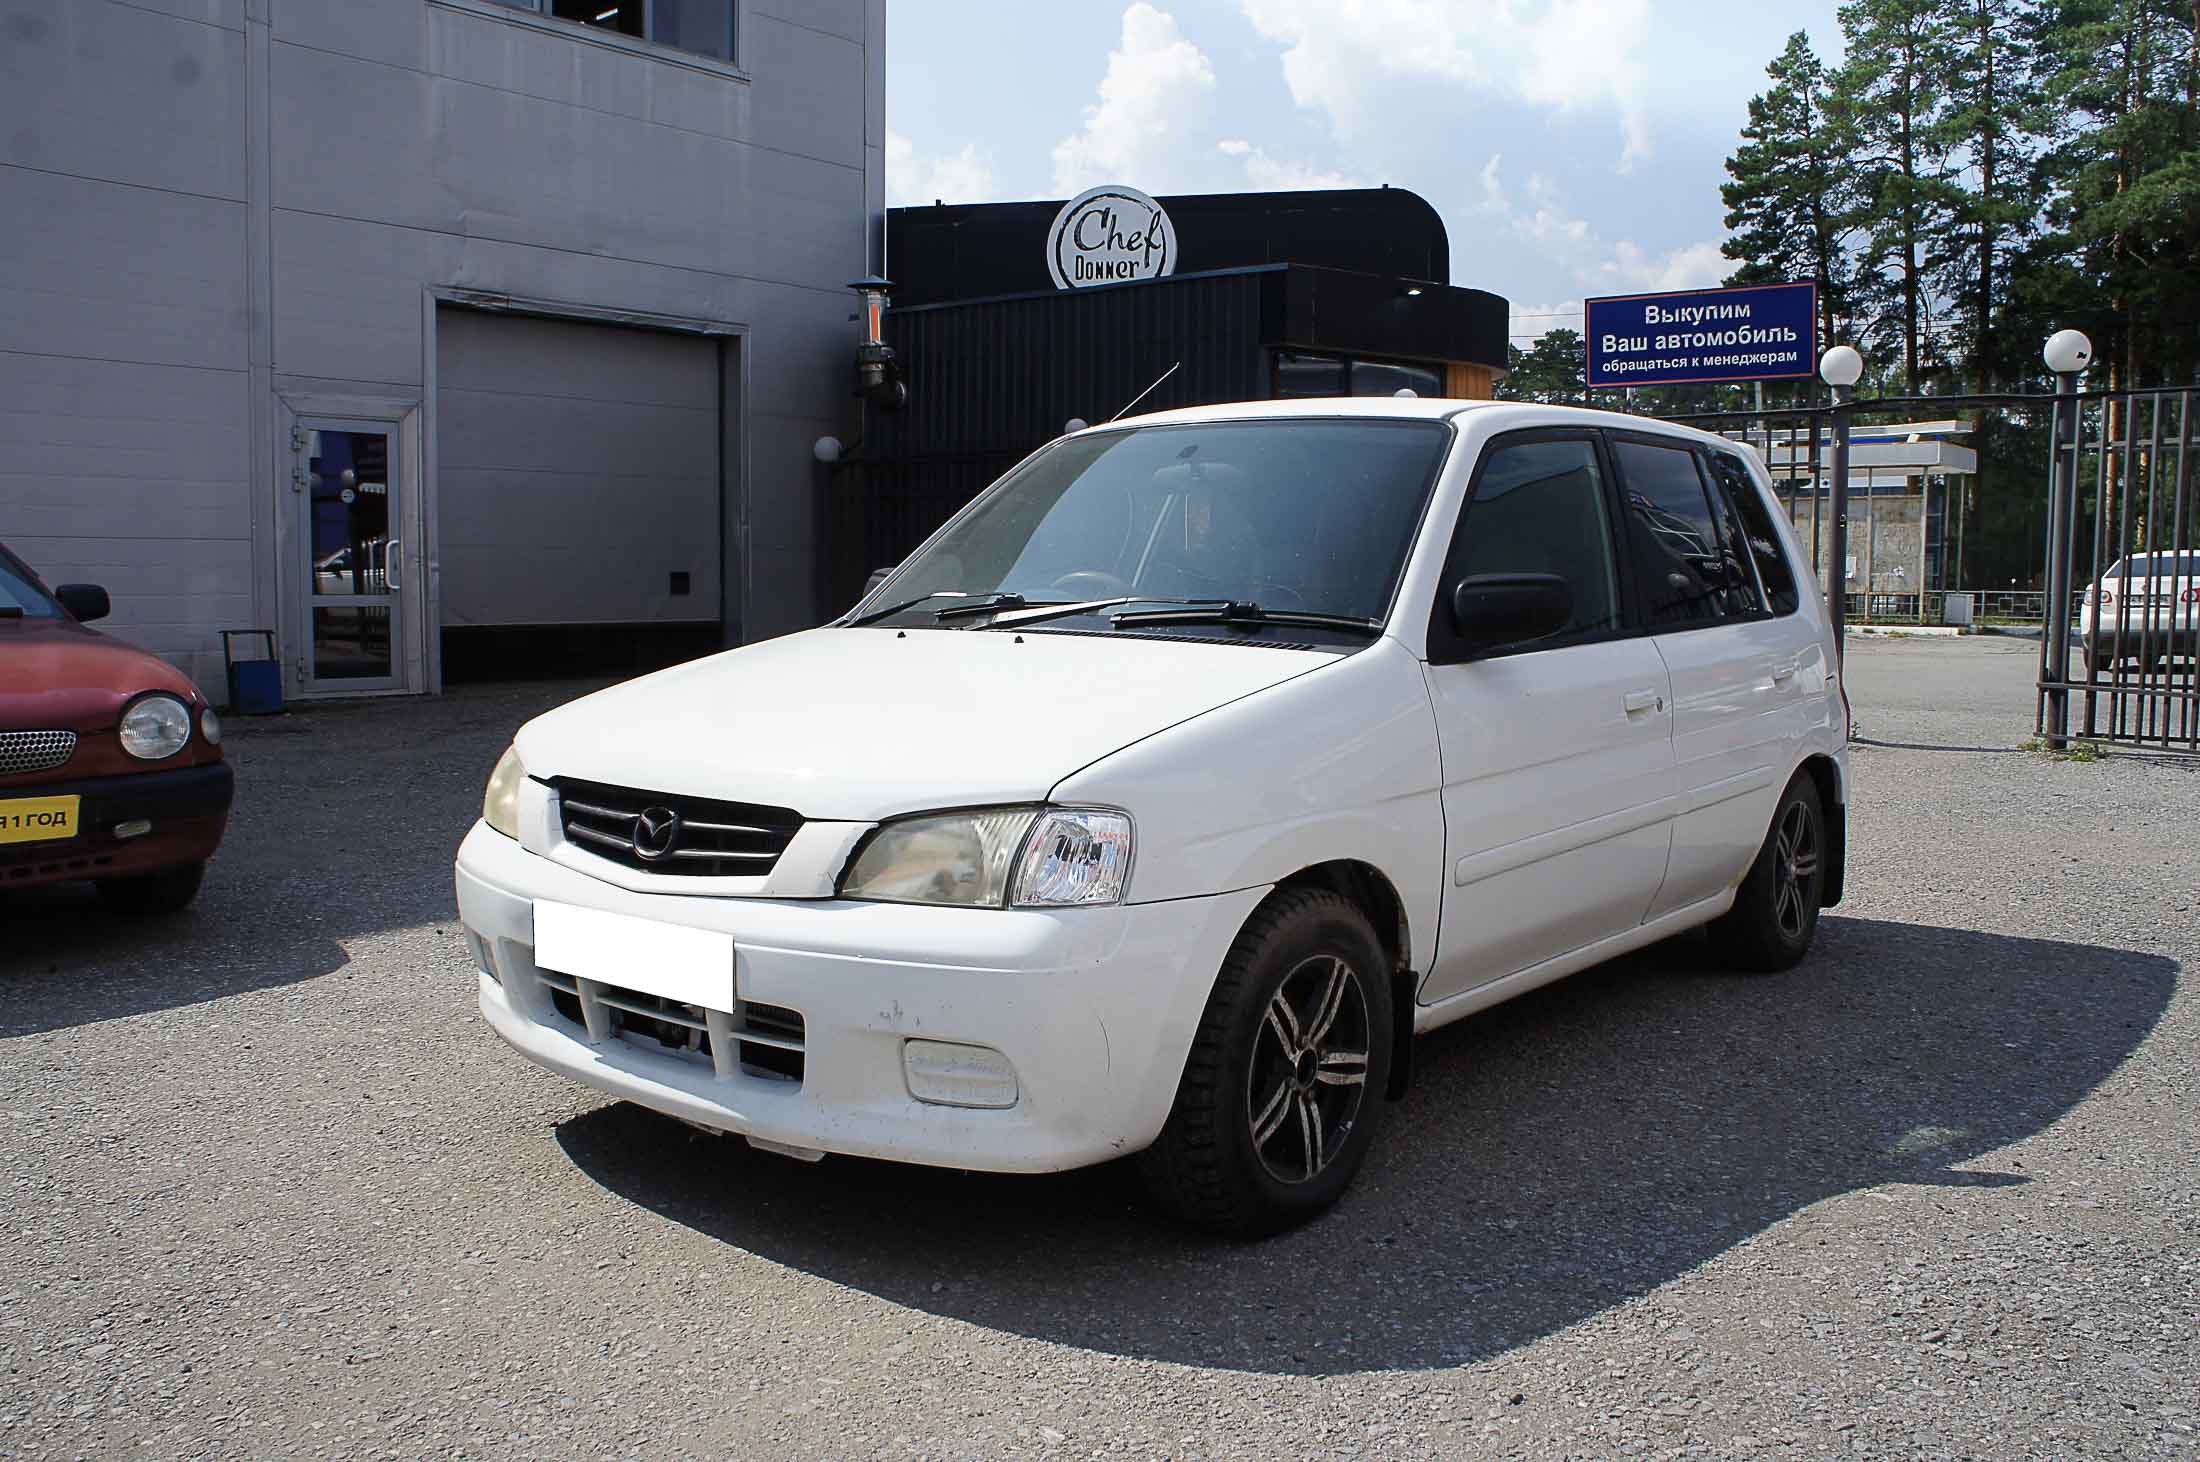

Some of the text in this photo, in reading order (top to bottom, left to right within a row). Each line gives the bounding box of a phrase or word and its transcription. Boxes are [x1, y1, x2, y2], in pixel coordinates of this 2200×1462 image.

[1073, 207, 1162, 269] Chef
[1645, 304, 1751, 326] Выкупим
[1602, 326, 1797, 353] Ваш автомобиль
[1602, 351, 1798, 373] обращаться к менеджерам
[12, 815, 20, 828] 1
[26, 811, 67, 827] ГОД
